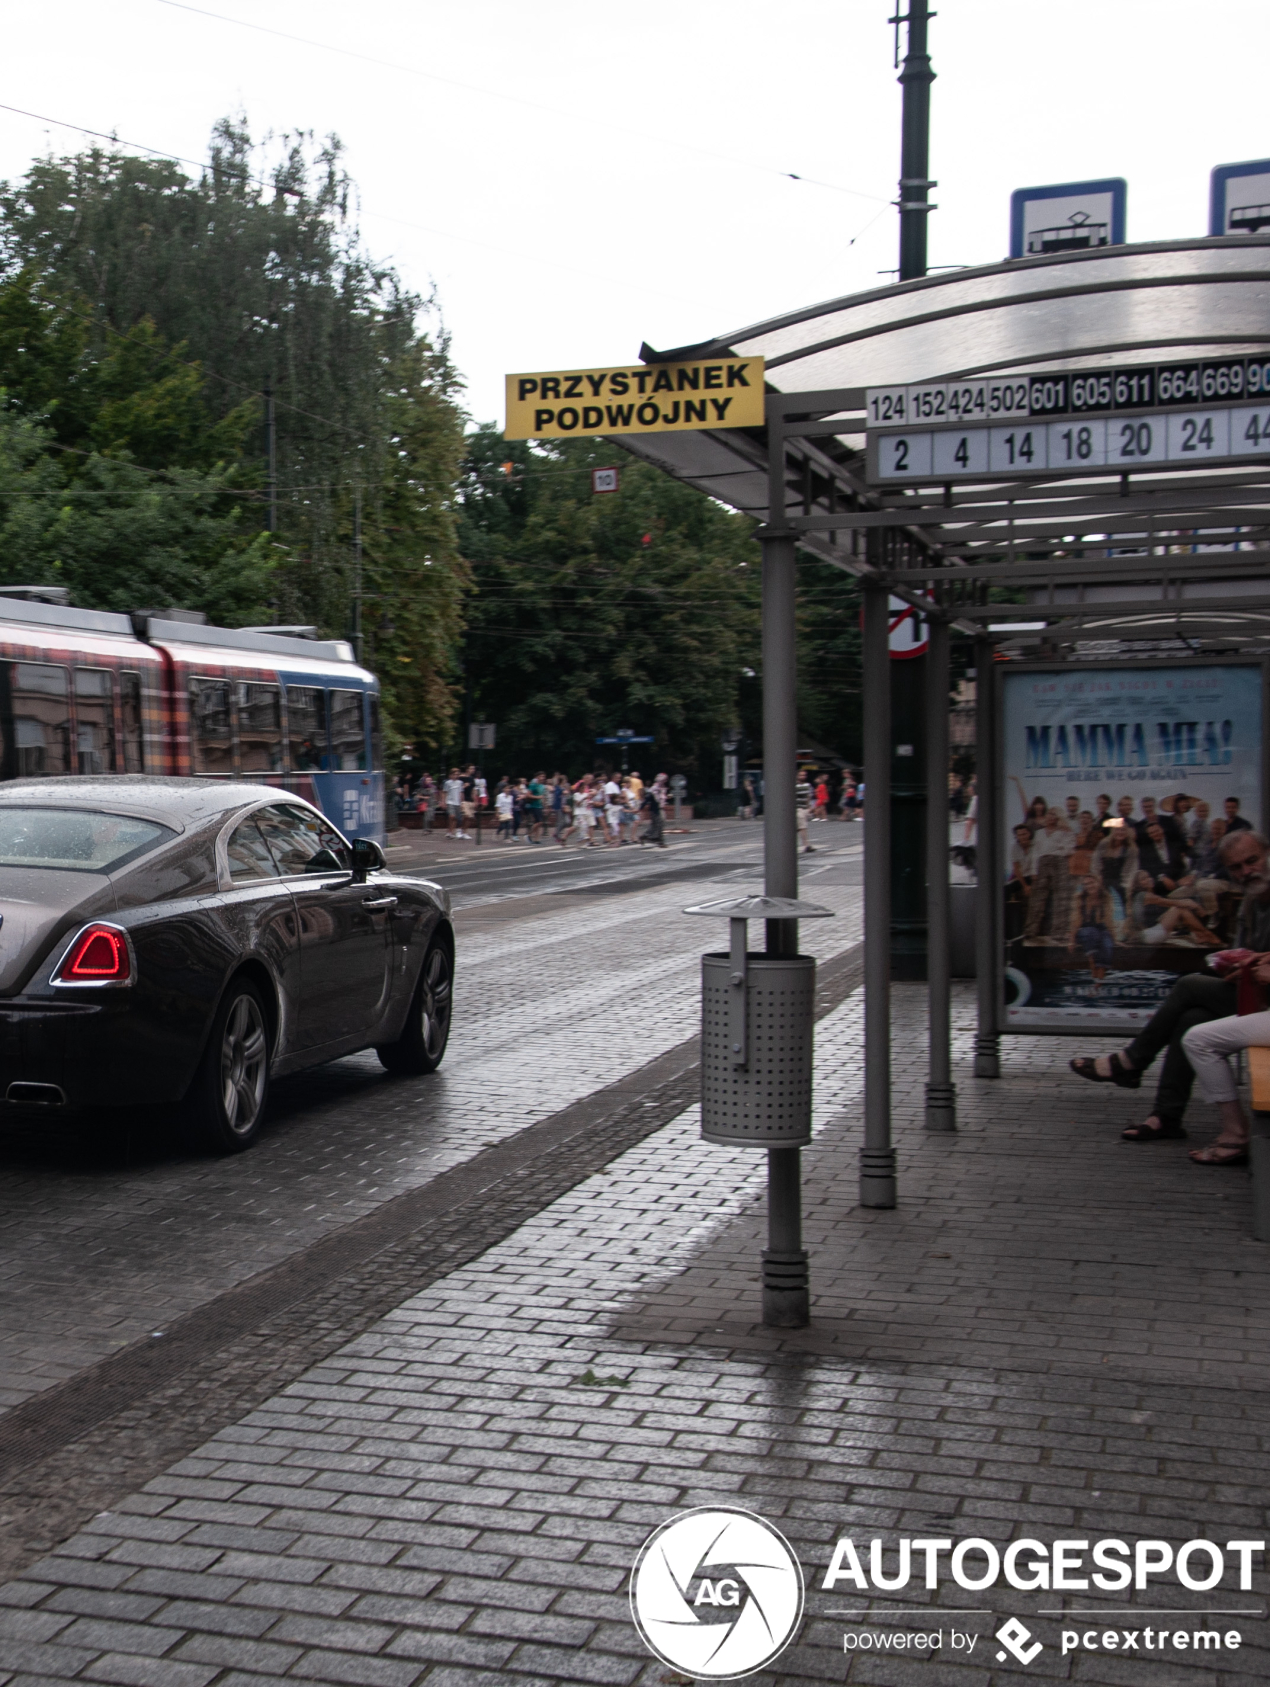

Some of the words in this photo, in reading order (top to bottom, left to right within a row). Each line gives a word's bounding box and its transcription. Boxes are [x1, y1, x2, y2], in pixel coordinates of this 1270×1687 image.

[518, 363, 751, 401] PRZYSTANEK
[871, 394, 905, 421] 124
[912, 390, 946, 418] 152
[948, 387, 986, 414] 424
[989, 384, 1028, 412] 502
[1031, 380, 1066, 410] 601
[1072, 377, 1111, 406] 605
[1115, 375, 1150, 403] 611
[1158, 370, 1199, 399] 664
[1202, 365, 1244, 397] 669
[534, 396, 734, 431] PODWÓJNY
[894, 439, 909, 471] 2
[955, 437, 969, 468] 4
[1004, 432, 1034, 464] 14
[1062, 426, 1092, 460] 18
[1120, 422, 1152, 457] 20
[1182, 418, 1214, 452] 24
[1025, 724, 1149, 768] MAMMA
